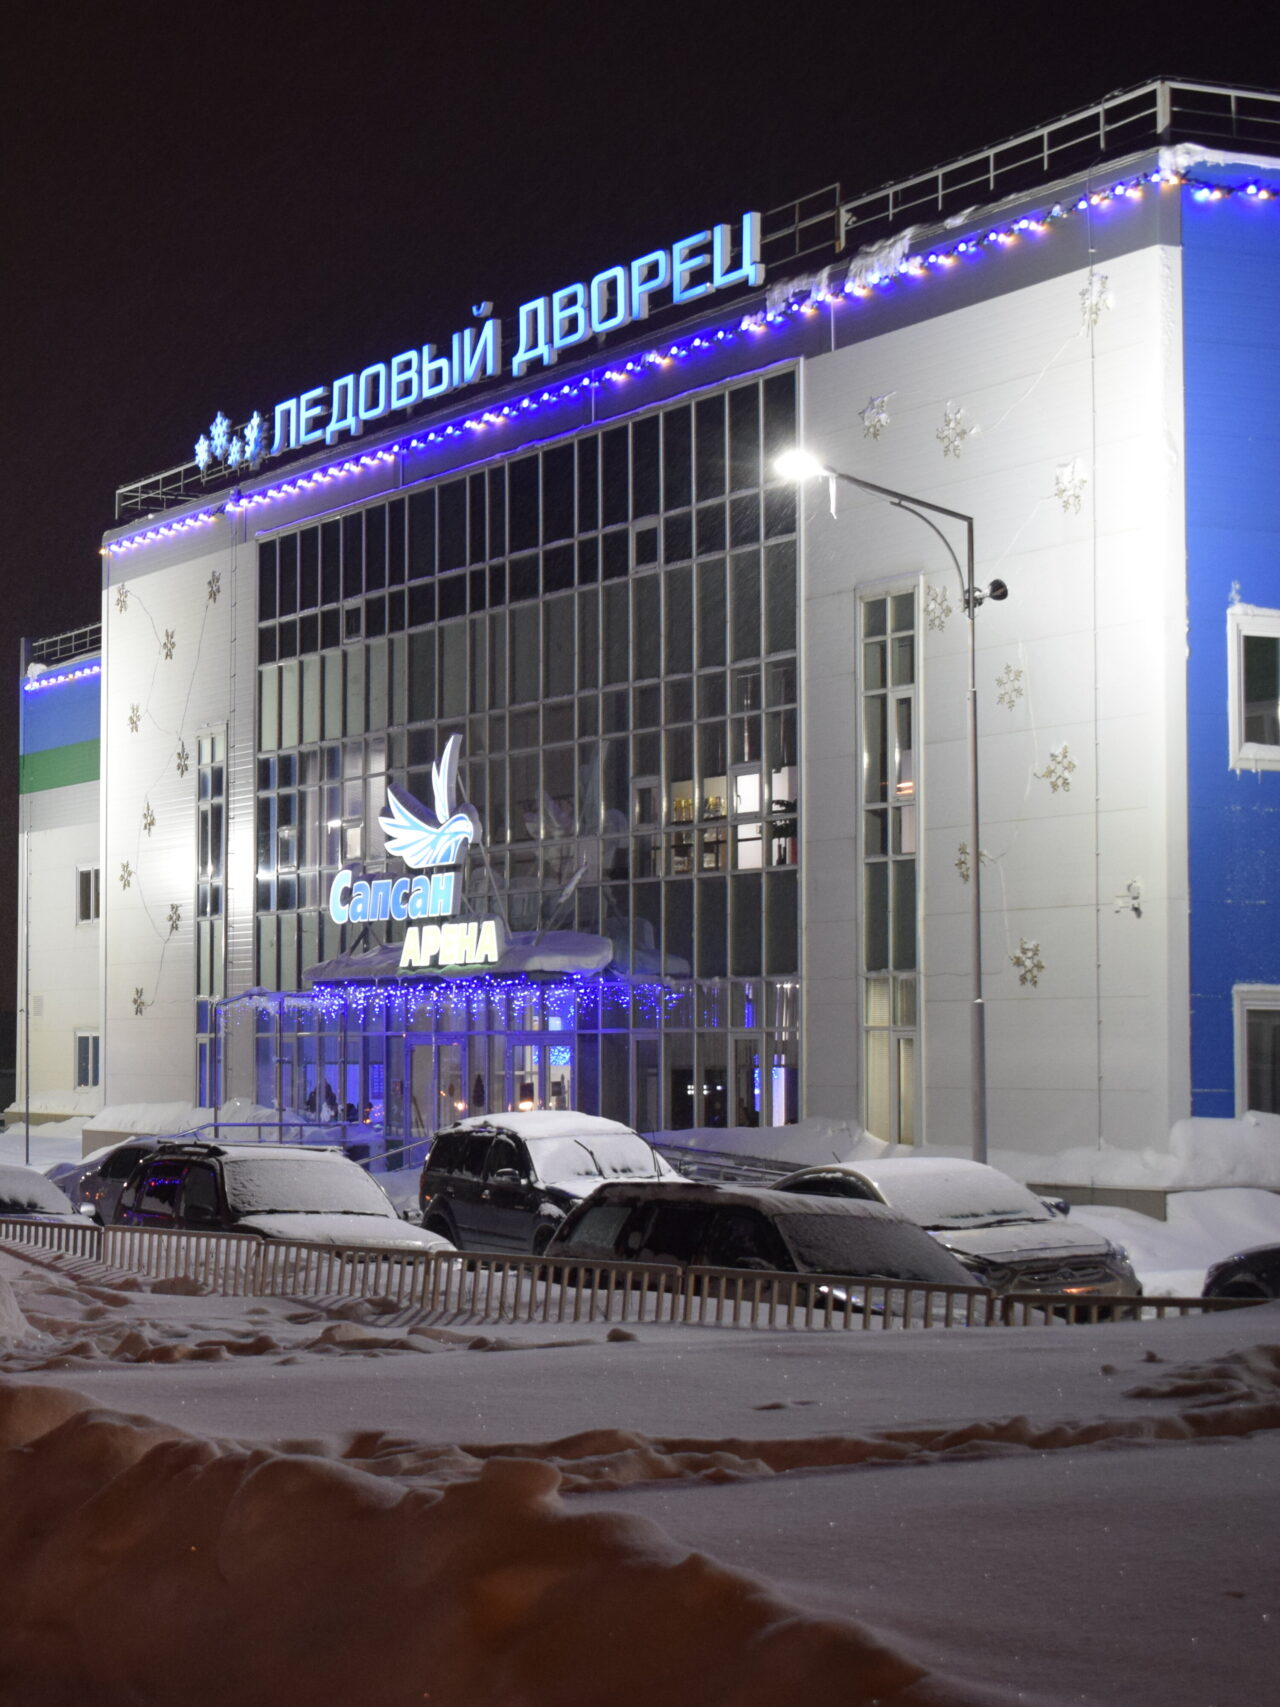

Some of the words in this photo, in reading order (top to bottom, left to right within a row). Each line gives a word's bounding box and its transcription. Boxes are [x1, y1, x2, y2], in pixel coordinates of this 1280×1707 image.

[270, 301, 501, 455] ЛЕДОВЫЙ
[513, 211, 765, 377] ДВОРЕЦ
[329, 869, 456, 924] Сапсан
[399, 920, 498, 968] АРЕНА
